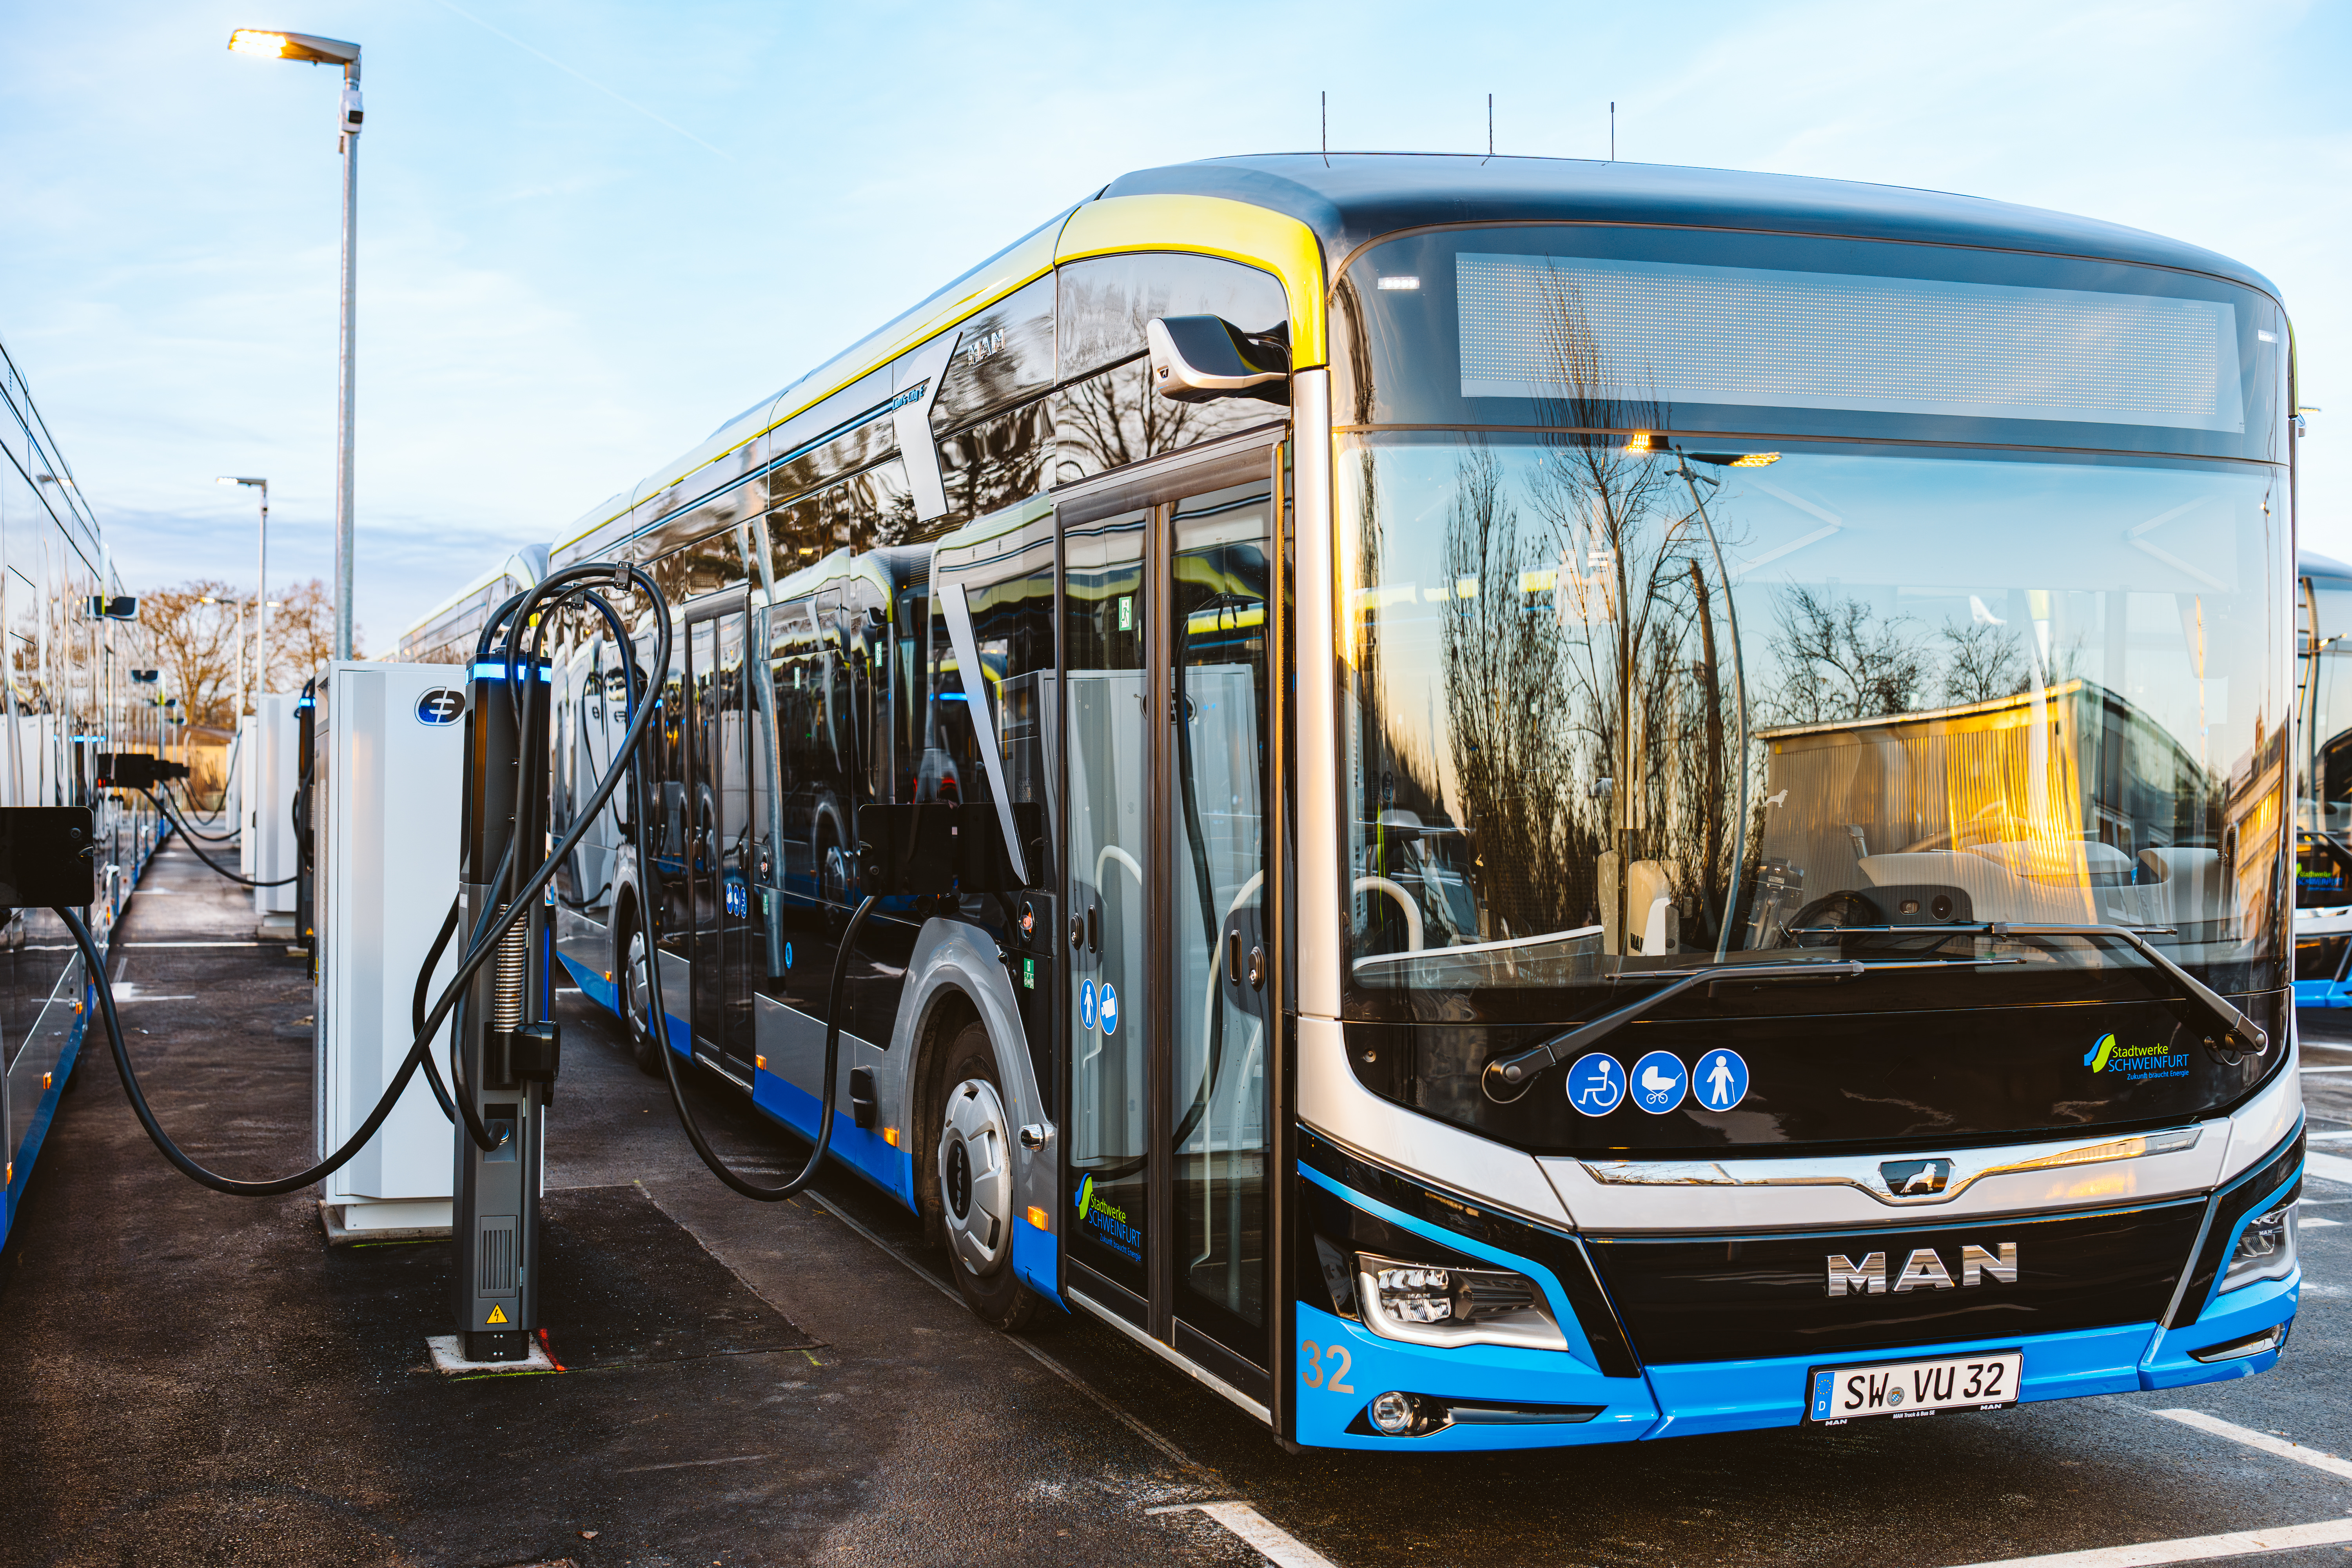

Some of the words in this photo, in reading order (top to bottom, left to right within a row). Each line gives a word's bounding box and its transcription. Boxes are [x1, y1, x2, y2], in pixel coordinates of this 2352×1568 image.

[968, 328, 1005, 366] MAN
[892, 394, 908, 410] Lion's
[908, 389, 920, 402] City
[920, 385, 925, 397] E
[2108, 1054, 2189, 1072] SCHWEINFURT
[2112, 1043, 2169, 1058] Stadtwerke
[1091, 1194, 1126, 1223] Stadtwerke
[1089, 1208, 1141, 1248] SCHWEINFURT
[1100, 1233, 1113, 1247] Zukunft
[1113, 1239, 1127, 1254] braucht
[1127, 1247, 1141, 1262] Energie
[1826, 1242, 2018, 1298] MAN
[1301, 1339, 1354, 1394] 32
[1844, 1373, 1889, 1410] SW
[1914, 1366, 1955, 1403] VU
[1963, 1363, 2004, 1398] 32
[1818, 1401, 1826, 1411] D
